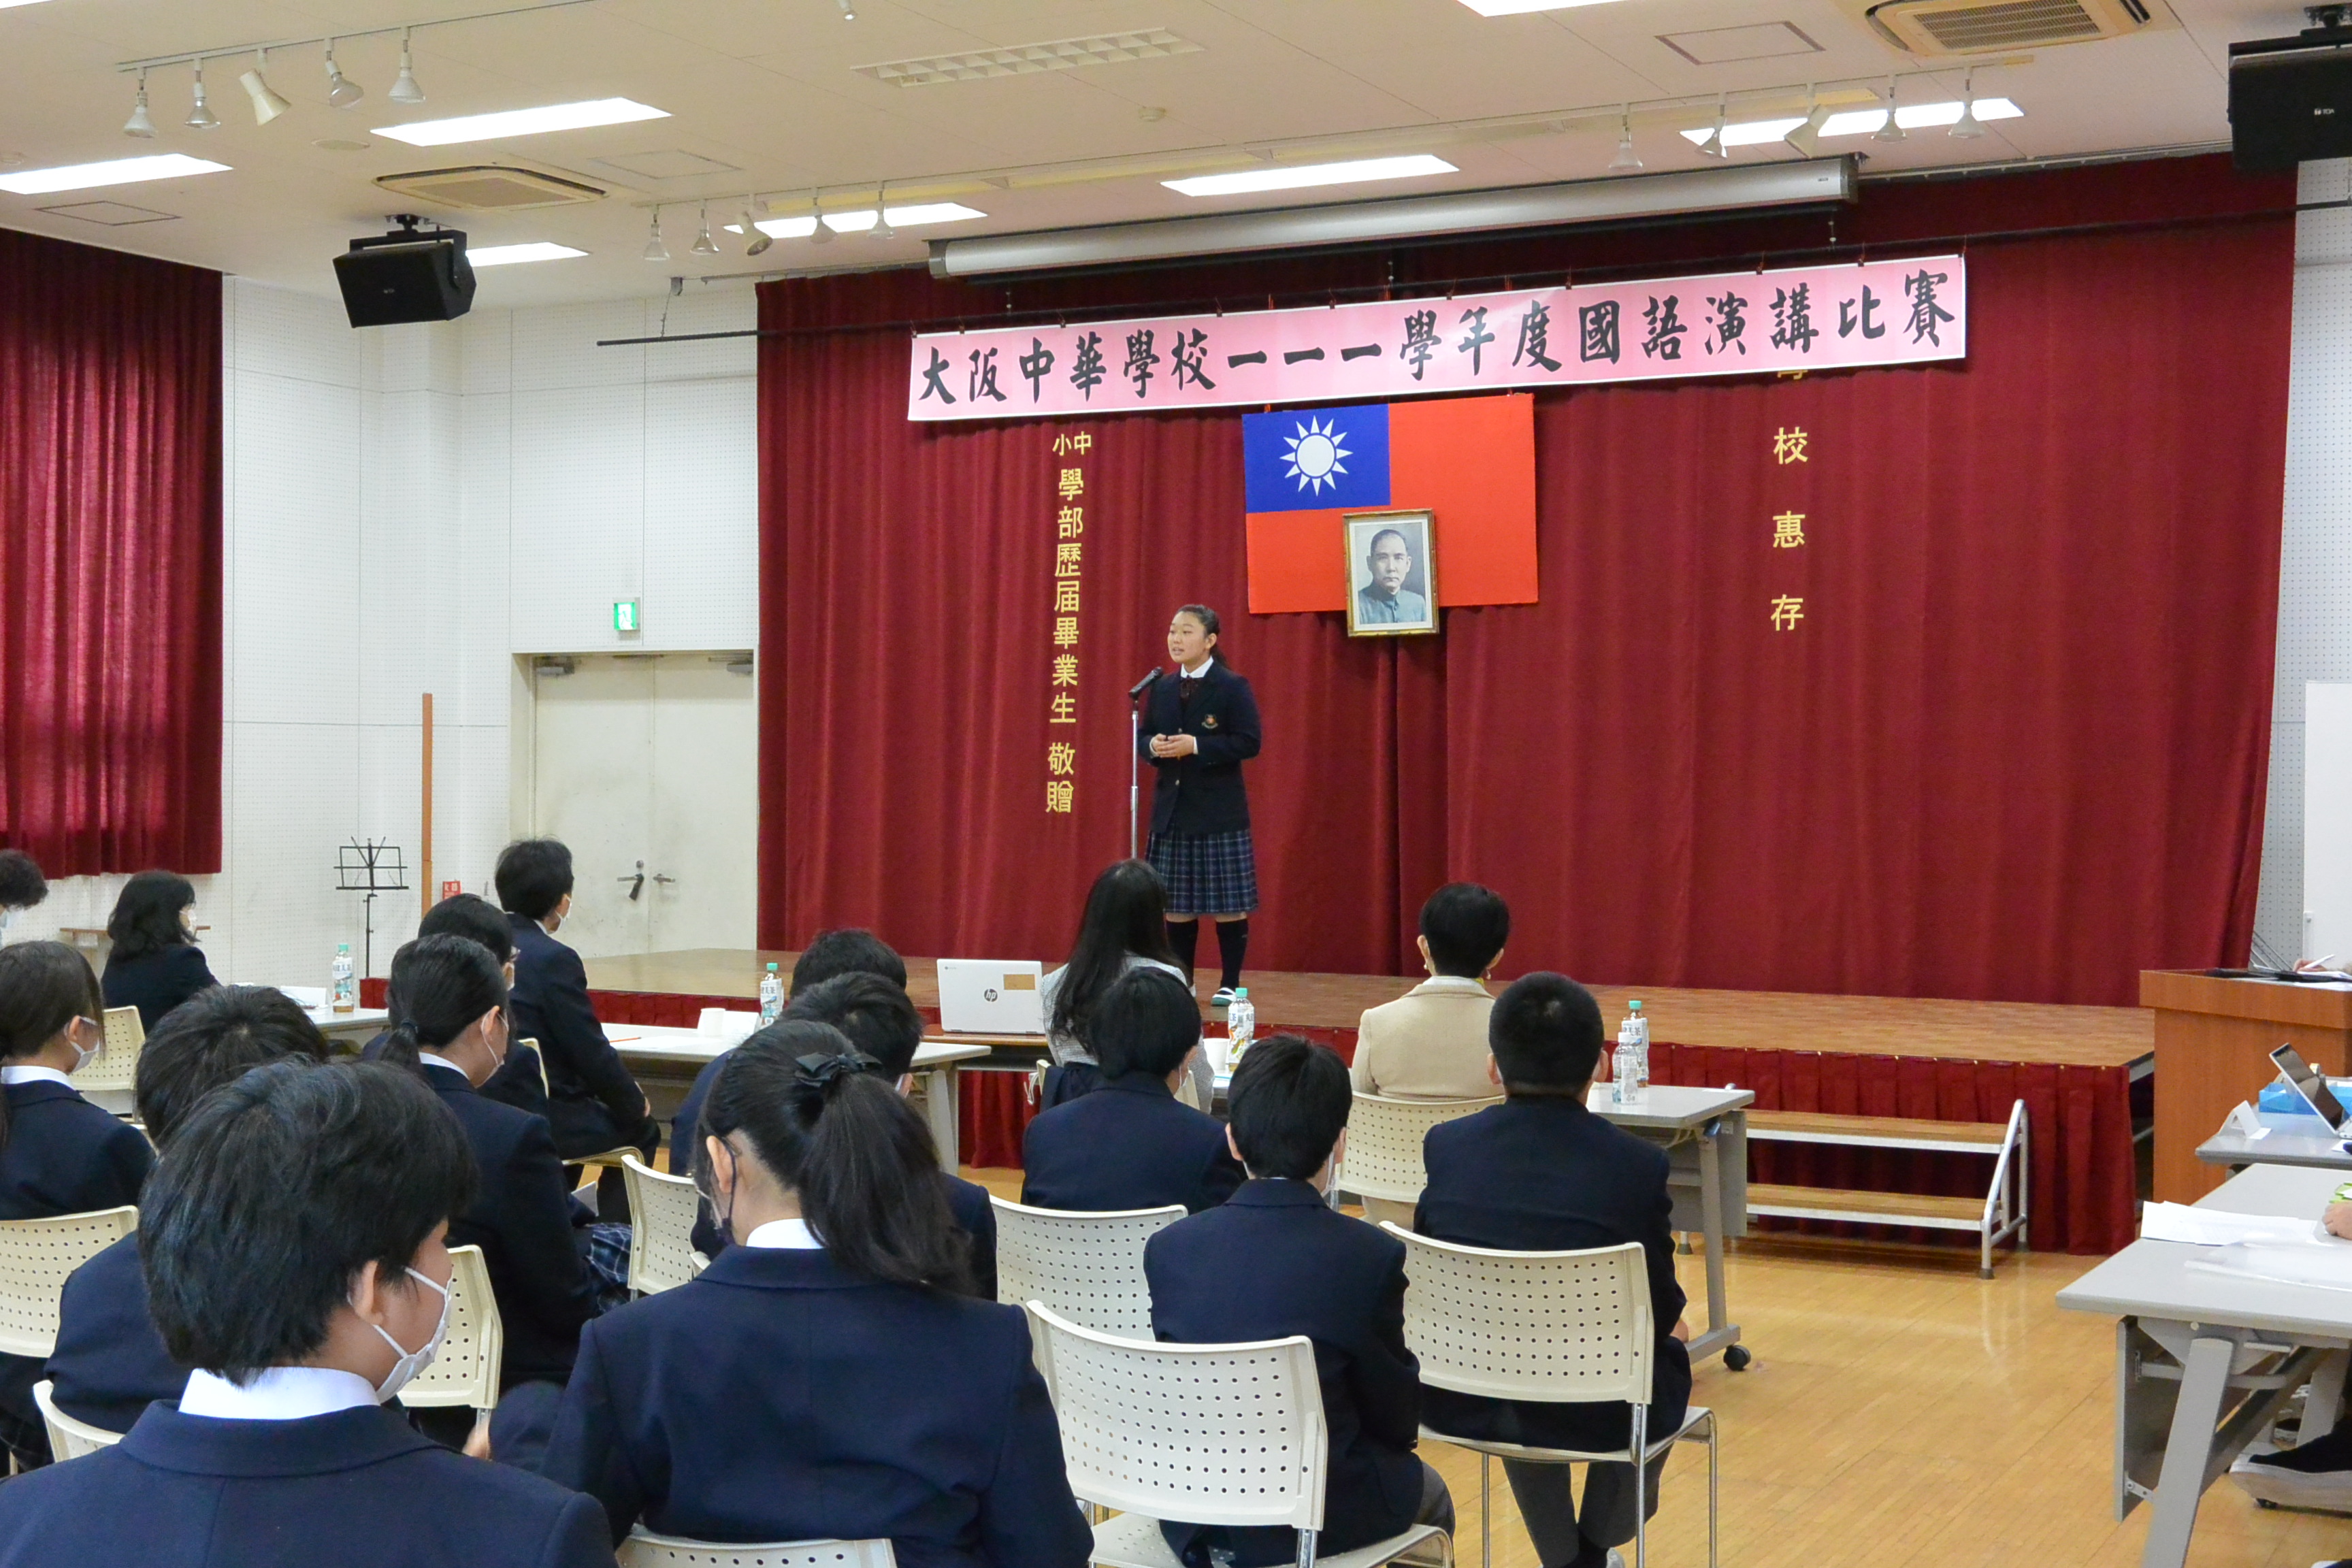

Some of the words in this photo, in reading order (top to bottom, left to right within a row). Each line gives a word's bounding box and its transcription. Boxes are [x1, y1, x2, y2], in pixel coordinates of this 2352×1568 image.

[919, 269, 1955, 404] 大阪中華學校一一一學年度國語演講比賽
[985, 988, 998, 1002] hp
